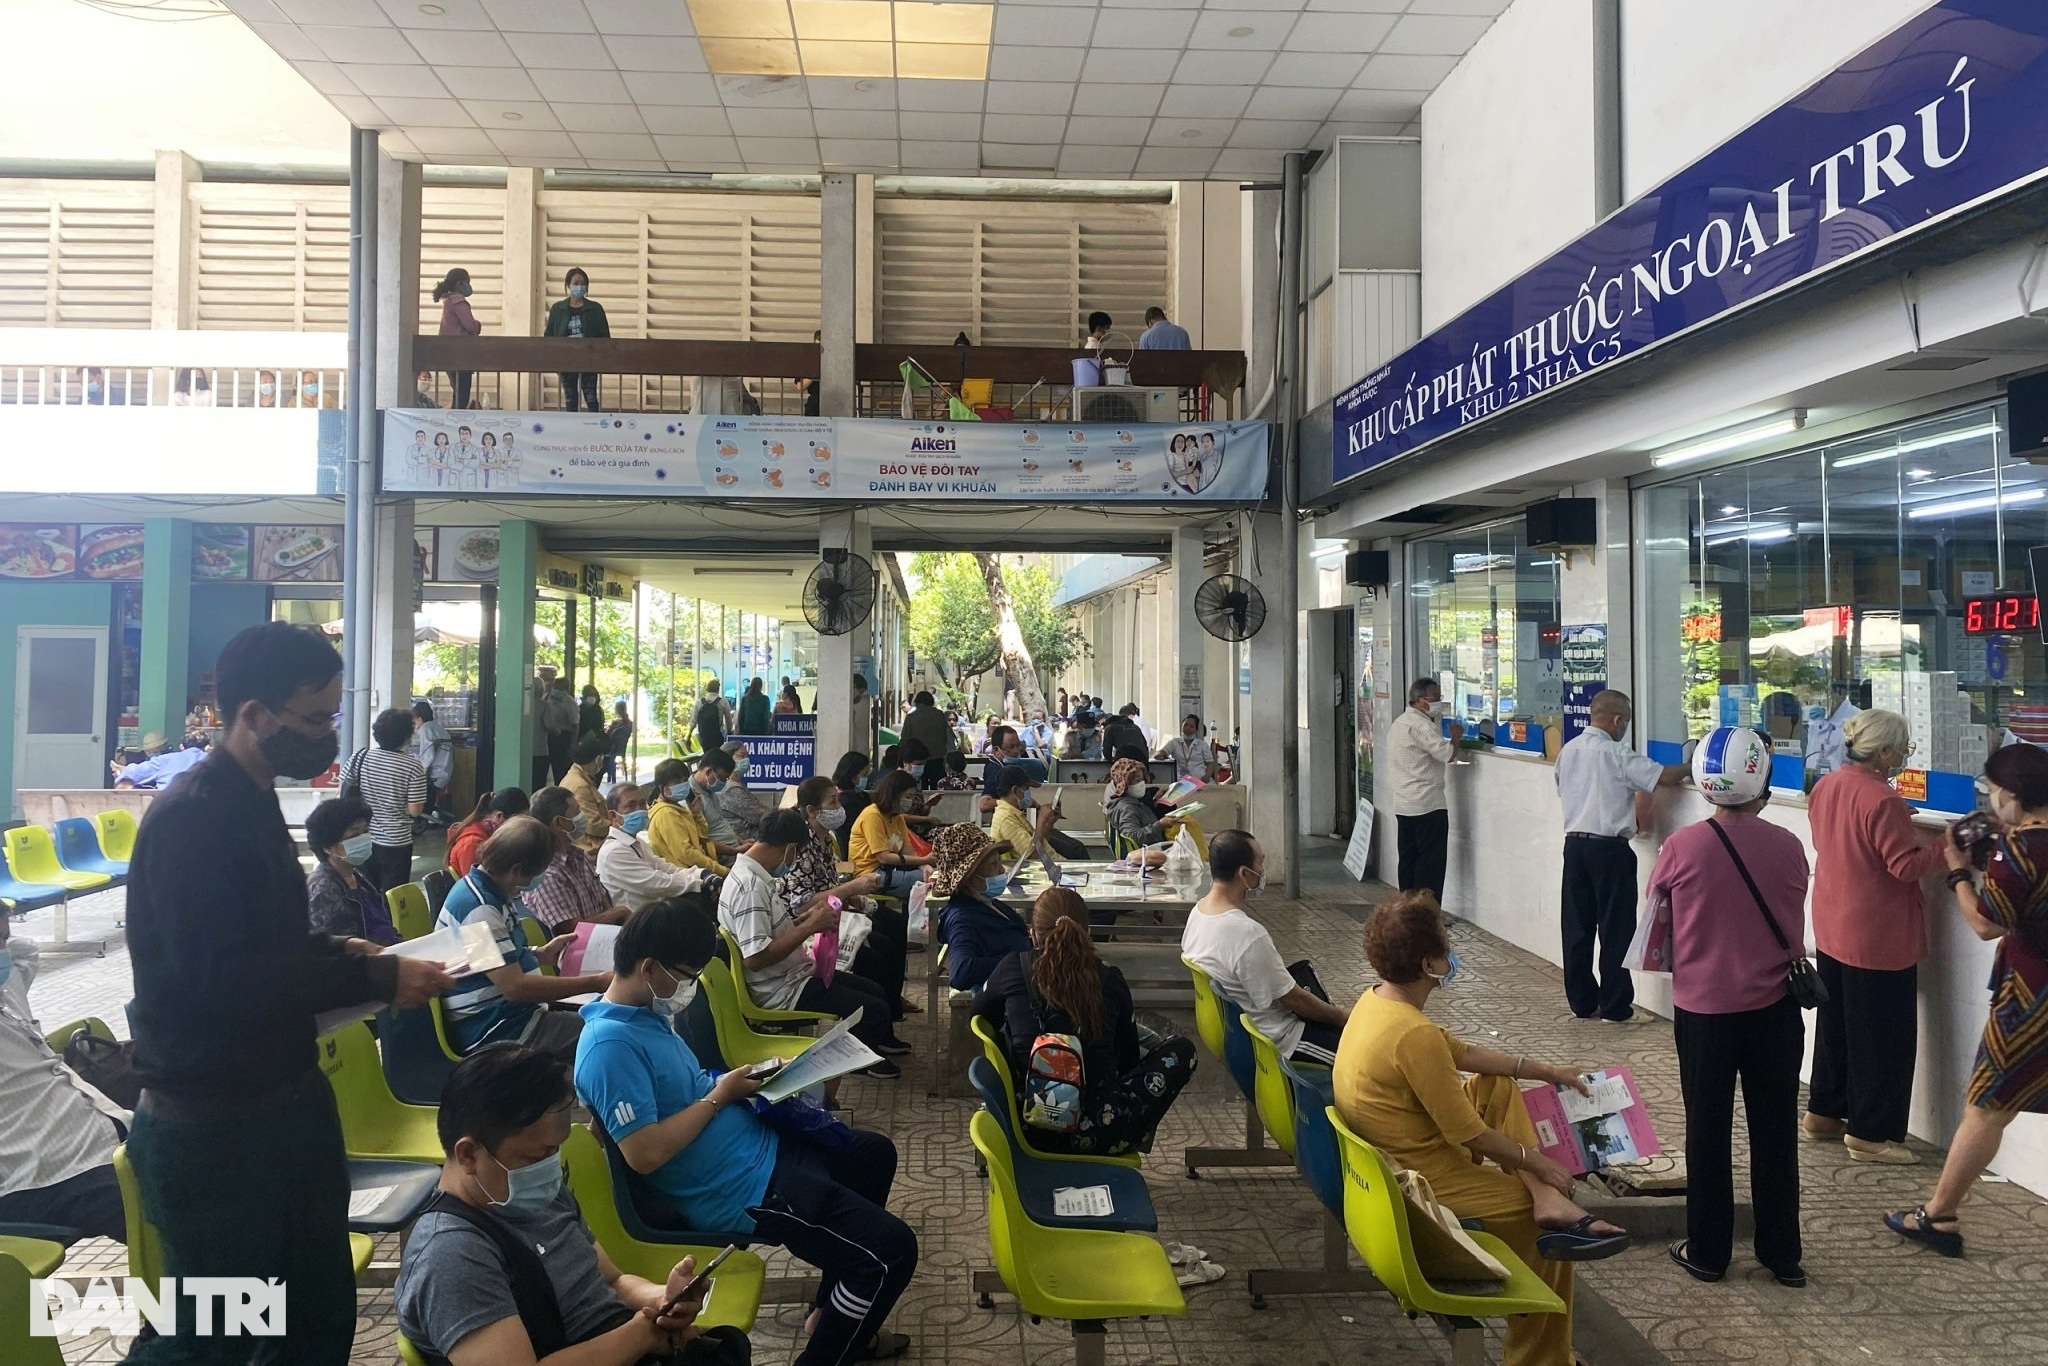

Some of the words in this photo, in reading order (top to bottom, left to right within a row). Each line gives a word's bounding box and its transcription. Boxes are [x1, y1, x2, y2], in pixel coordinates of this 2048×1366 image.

[1348, 408, 1387, 456] KHU
[1388, 371, 1430, 435] CẤP
[1432, 343, 1497, 413] PHÁT
[1504, 265, 1624, 381] THUỐC
[1631, 177, 1795, 316] NGOẠI
[1810, 56, 1976, 224] TRÚ
[1460, 389, 1502, 425] KHU
[1508, 381, 1519, 403] 2
[1526, 355, 1582, 395] NHÀ
[1587, 331, 1622, 366] C5
[716, 421, 737, 429] Aiken
[583, 445, 589, 453] 6
[634, 445, 648, 453] TAY
[911, 437, 956, 451] Aiken
[618, 459, 632, 468] gia
[879, 461, 908, 475] BẢO
[911, 463, 927, 478] VỆ
[931, 463, 954, 476] ĐÔI
[958, 465, 980, 476] TAY
[869, 478, 905, 492] ĐÁNH
[909, 482, 933, 492] BAY
[937, 482, 948, 492] VI
[1967, 598, 2038, 632] 6121
[777, 720, 797, 732] KHOA
[757, 739, 785, 755] KHÁM
[787, 740, 813, 759] BỆNH
[764, 762, 782, 778] YÊU
[784, 760, 803, 778] CẦU
